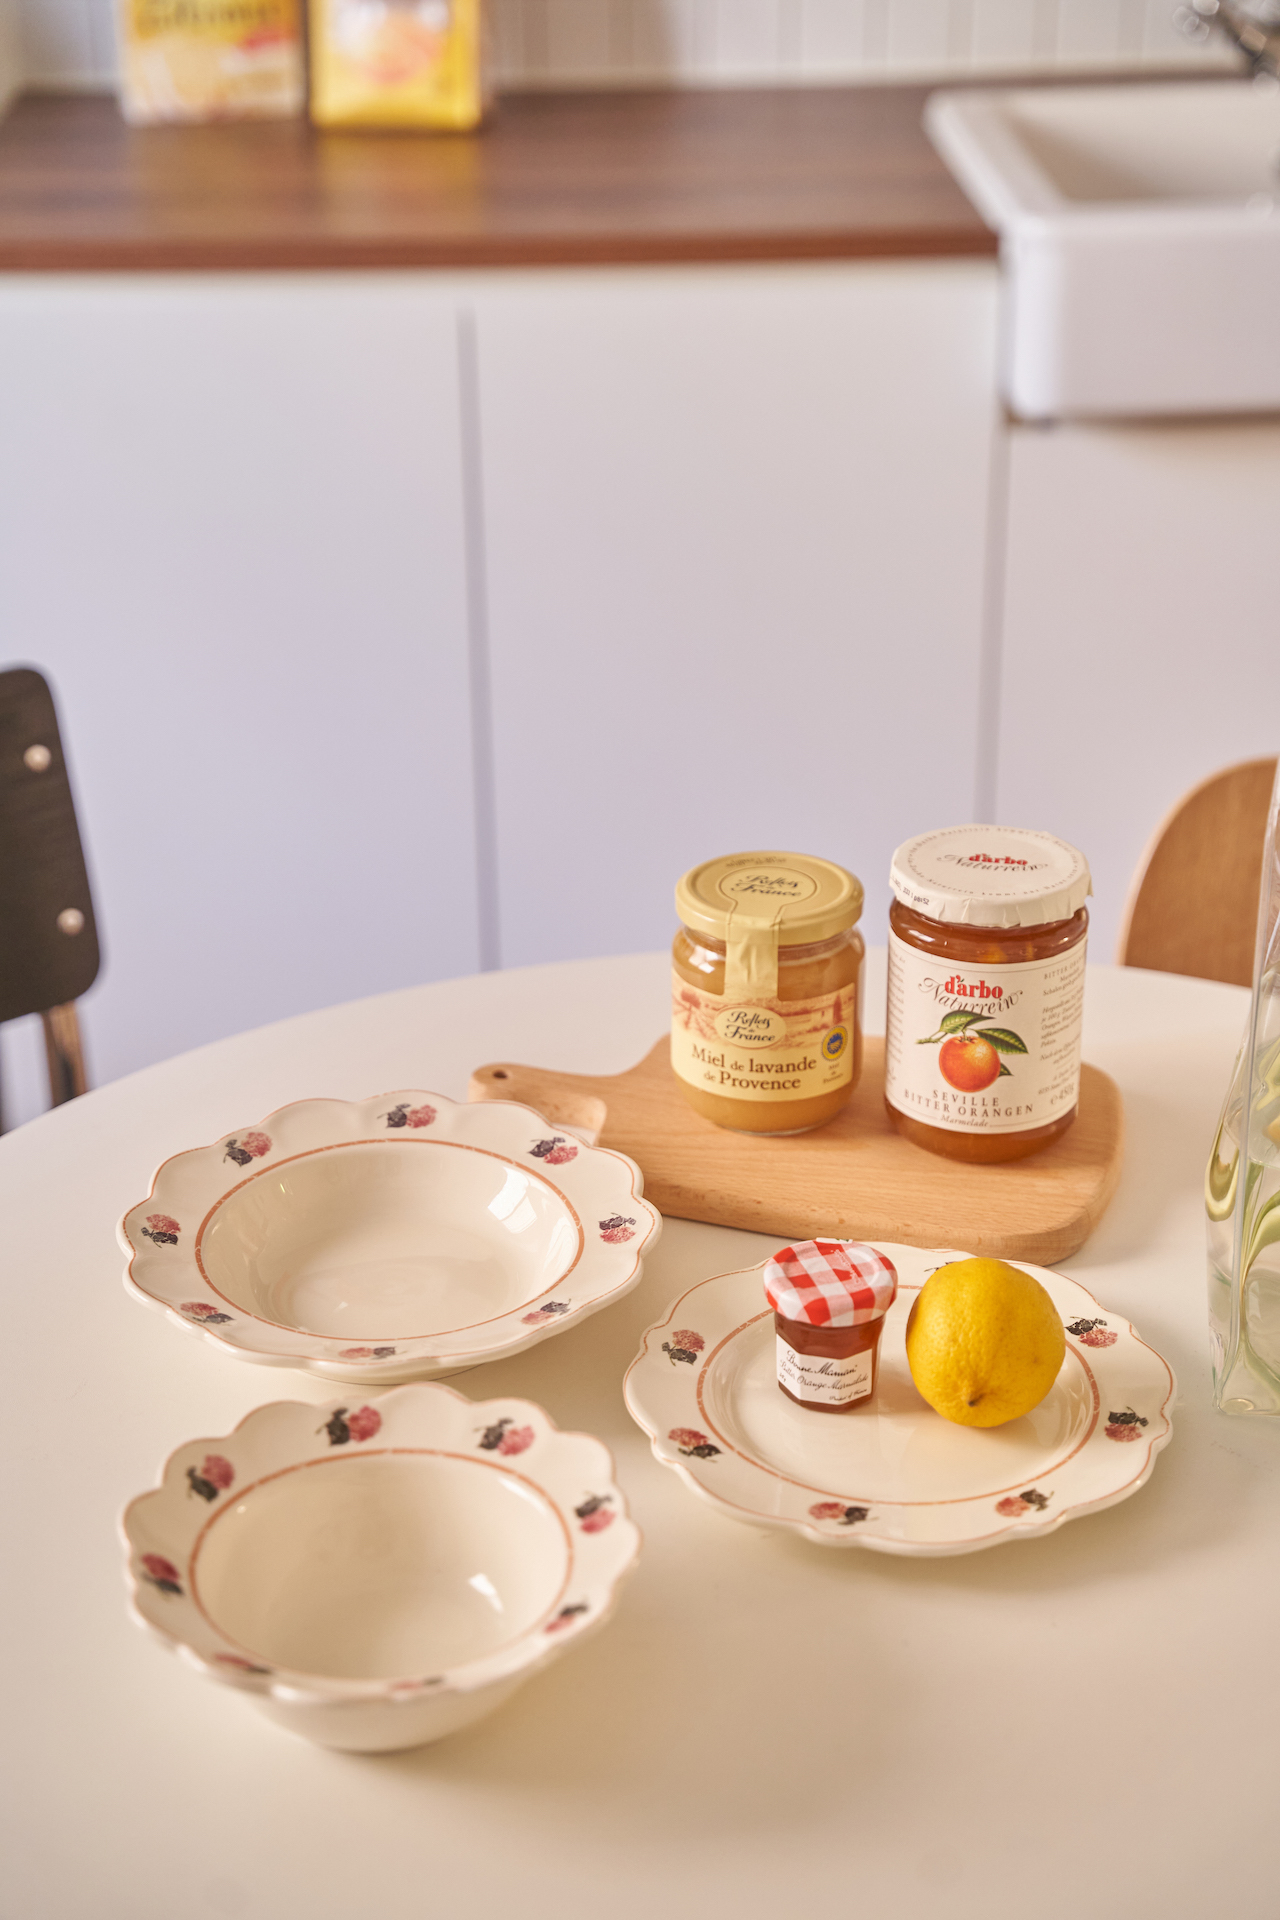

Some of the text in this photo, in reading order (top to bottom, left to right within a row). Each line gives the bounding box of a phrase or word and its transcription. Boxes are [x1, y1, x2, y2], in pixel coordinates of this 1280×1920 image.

[918, 977, 1024, 1015] Naturrein
[727, 1010, 774, 1029] Reflets
[724, 1024, 776, 1042] France
[692, 1044, 817, 1074] Miel de lavande
[703, 1070, 802, 1091] de Provence
[904, 1088, 1034, 1118] BITTER ORANGEN
[933, 1089, 1000, 1107] SEVILLE
[940, 1114, 989, 1128] Marmelade
[797, 1375, 826, 1391] Orange
